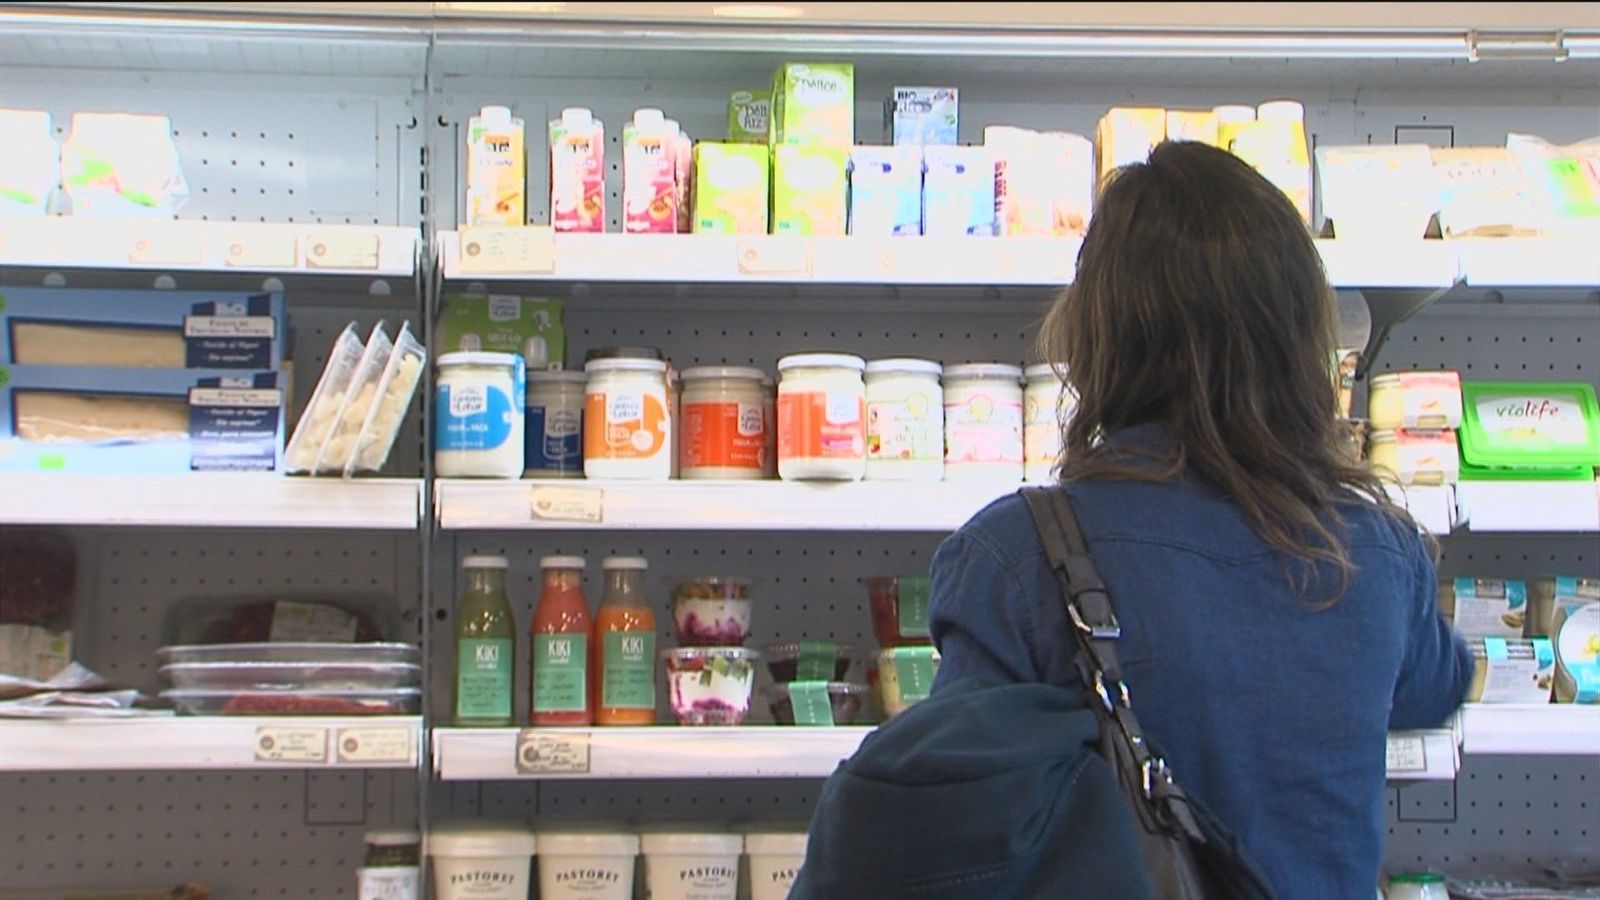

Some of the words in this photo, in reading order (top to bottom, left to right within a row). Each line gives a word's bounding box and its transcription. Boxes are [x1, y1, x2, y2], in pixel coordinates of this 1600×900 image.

[1496, 399, 1559, 421] violife
[476, 644, 499, 662] KIKI
[548, 639, 571, 657] KIKI
[622, 636, 644, 654] KIKI
[450, 871, 515, 885] PASTORET
[555, 870, 619, 883] PASTORET
